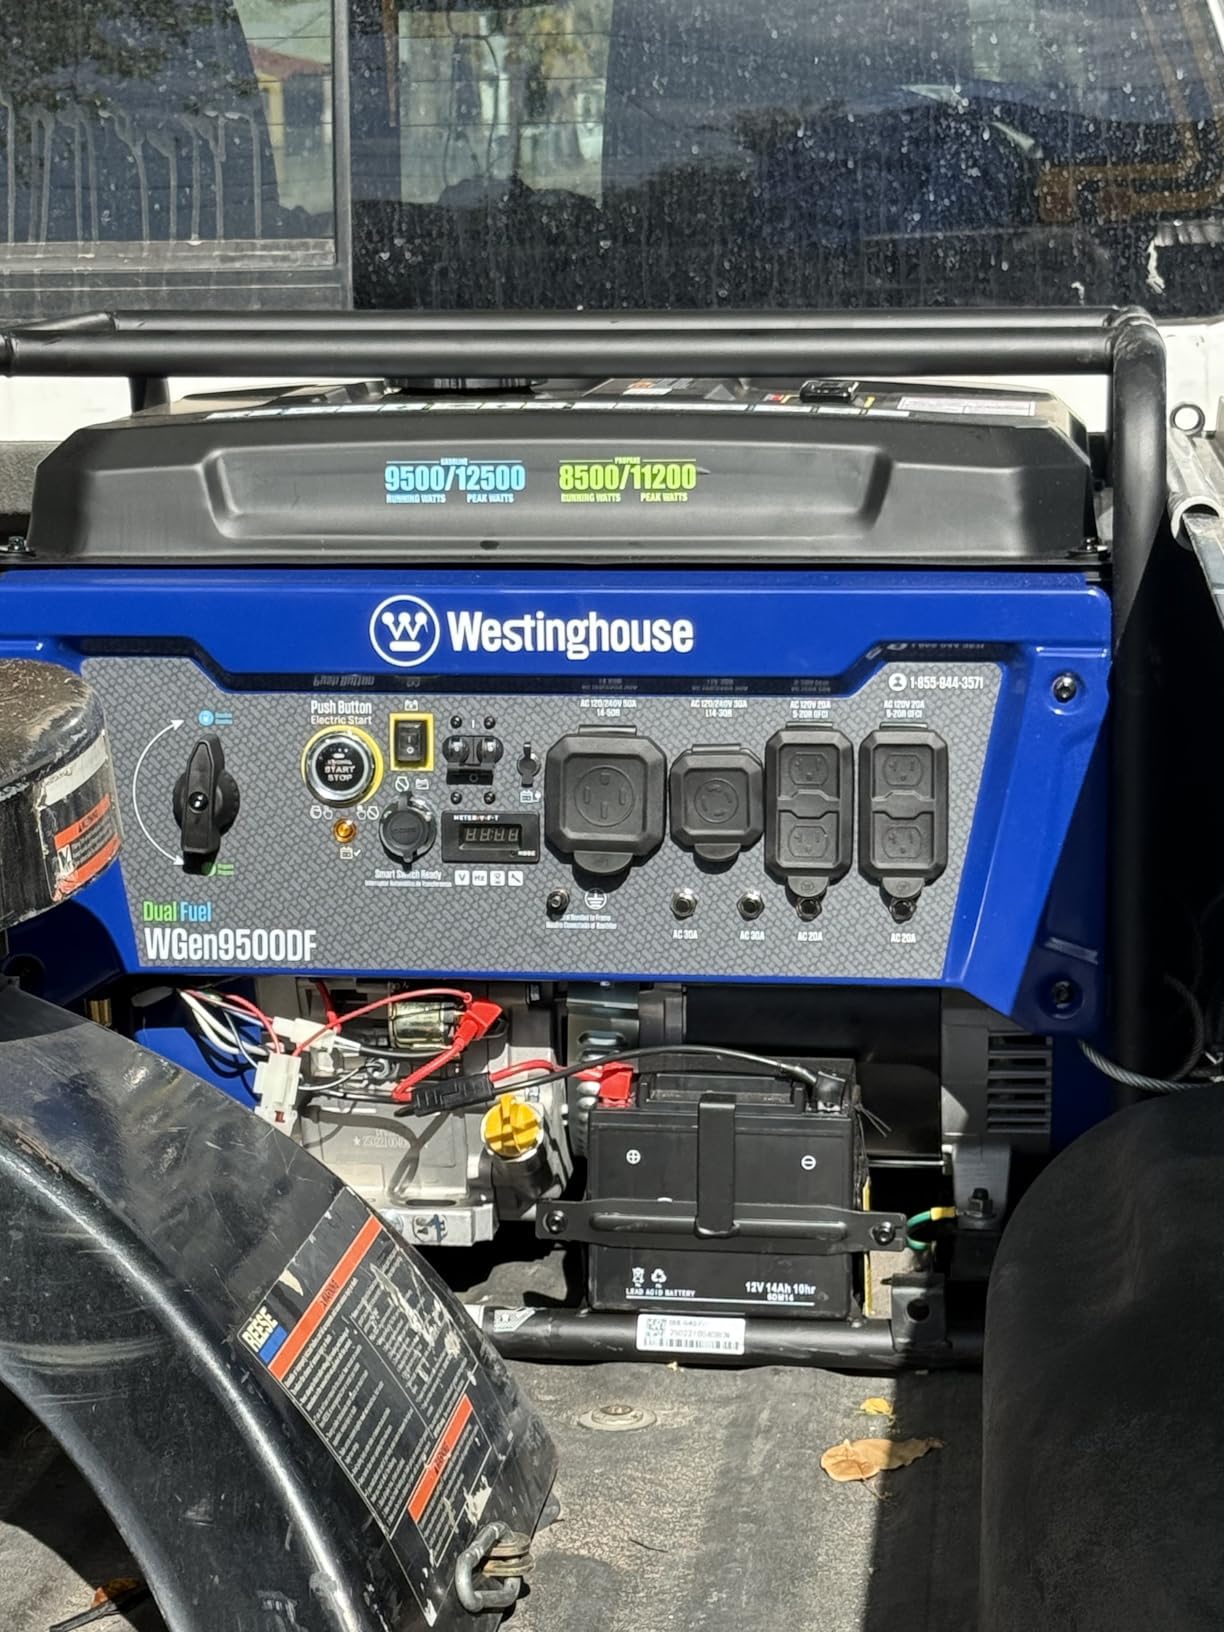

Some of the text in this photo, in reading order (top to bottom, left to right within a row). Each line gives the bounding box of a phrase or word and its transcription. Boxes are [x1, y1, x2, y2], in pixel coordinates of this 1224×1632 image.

[385, 465, 526, 491] 9500/12500
[559, 463, 697, 490] 8500/11200
[421, 494, 446, 503] WATTS
[467, 493, 514, 503] PEAK WATTS
[596, 493, 621, 502] WATTS
[640, 492, 688, 502] PEAK WATTS
[446, 610, 694, 661] Westinghouse
[311, 700, 372, 714] Push Button
[311, 715, 373, 725] Electric Start
[324, 765, 356, 774] START
[328, 774, 352, 782] STOP
[374, 869, 395, 880] Smart
[420, 869, 442, 881] Ready
[143, 901, 213, 922] Dual Fuel
[673, 929, 698, 939] AC 30A
[740, 930, 749, 940] AC
[798, 931, 823, 941] AC 20A
[890, 933, 916, 943] AC 20A
[144, 926, 318, 961] WGen9500DF
[645, 1288, 663, 1296] ACID
[664, 1289, 696, 1297] BATTERY
[745, 1281, 816, 1295] 12V 14Ah 10hr
[241, 1306, 278, 1353] REESE
